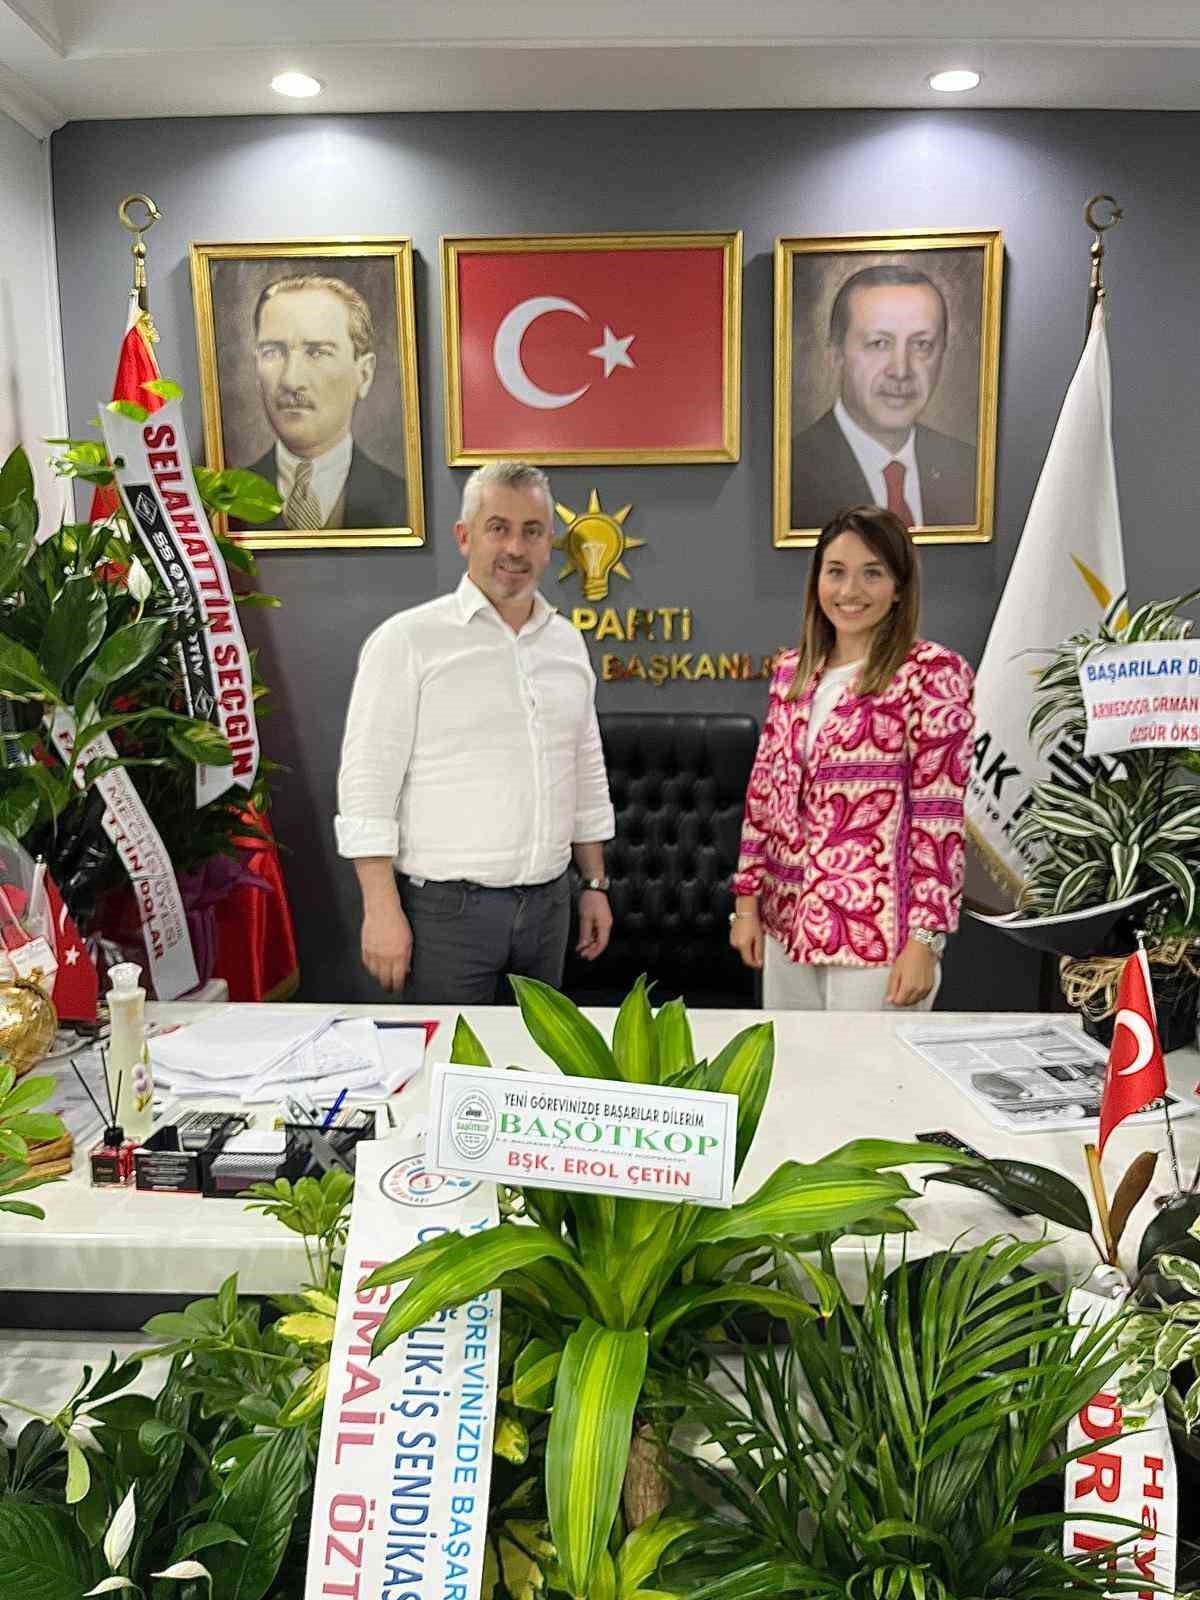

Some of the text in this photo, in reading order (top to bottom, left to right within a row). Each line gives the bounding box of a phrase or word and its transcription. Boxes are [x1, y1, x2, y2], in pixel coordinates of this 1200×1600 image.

[152, 531, 175, 561] SS
[143, 424, 255, 777] SELAHATTİN SEÇGİN
[571, 607, 692, 641] PARTİ
[1087, 659, 1182, 683] BAŞARILAR
[1152, 696, 1199, 713] ORMAN
[973, 731, 1022, 800] AK
[505, 1090, 528, 1108] YENİ
[530, 1092, 600, 1117] GÖREVİNİZDE
[604, 1103, 659, 1123] BAŞARILAR
[663, 1107, 704, 1128] DİLERİM
[499, 1112, 719, 1156] BAŞÖTKOP
[508, 1150, 555, 1174] BŞK.
[564, 1157, 618, 1180] EROL
[627, 1164, 691, 1187] ÇETİN
[391, 1306, 457, 1418] LIK-İŞ
